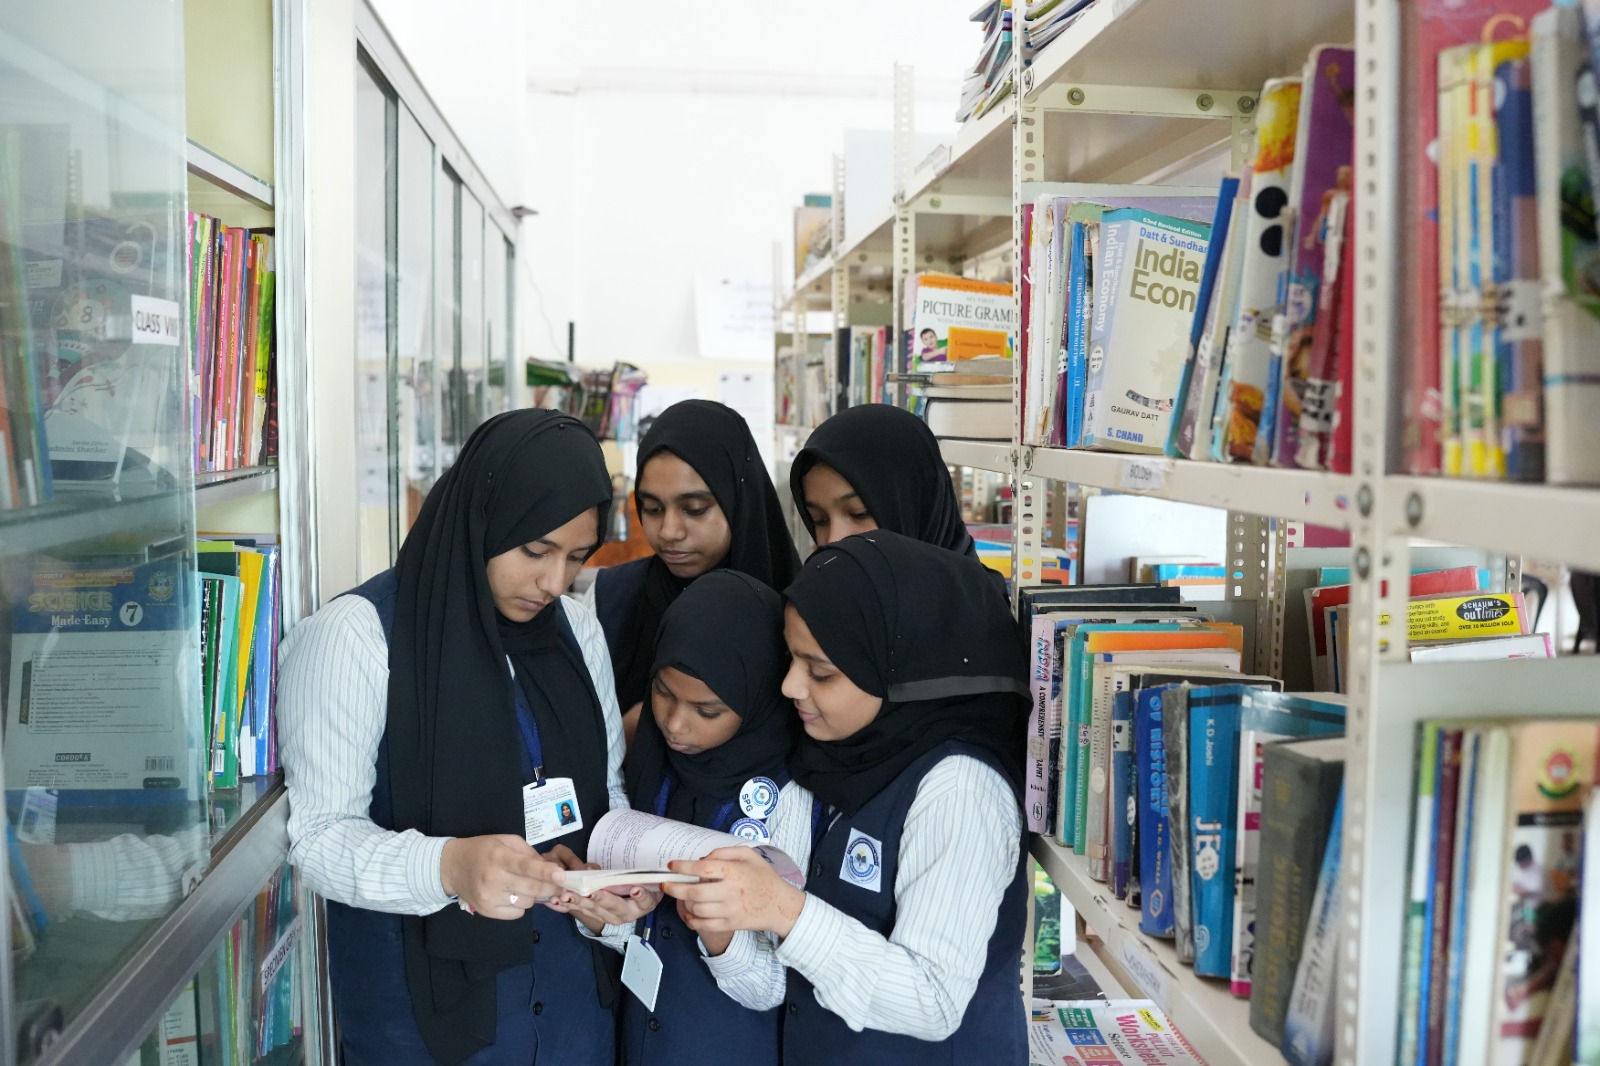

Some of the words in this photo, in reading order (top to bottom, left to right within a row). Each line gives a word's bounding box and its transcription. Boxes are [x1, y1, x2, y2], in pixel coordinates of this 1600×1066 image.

[1103, 223, 1121, 267] Indian
[1140, 227, 1159, 242] Datt
[1160, 233, 1167, 244] &
[1169, 235, 1208, 254] Sundhar
[1134, 238, 1200, 285] India
[1075, 276, 1083, 318] CHEMISTRY
[1094, 269, 1114, 332] Economy
[1129, 268, 1197, 314] Econ
[80, 305, 93, 324] 8
[135, 310, 160, 335] CLASS
[922, 300, 972, 320] PICTURE
[1110, 405, 1140, 418] GAURAV
[1141, 412, 1160, 422] DATT
[1107, 427, 1114, 437] S.
[1115, 429, 1144, 443] CHAND
[48, 445, 75, 453] admini
[28, 591, 113, 612] SCIENCE
[125, 604, 139, 623] 7
[1462, 600, 1502, 610] SCHAUM'S
[1480, 621, 1501, 629] MILLION
[1037, 691, 1046, 738] COMPREHENSIV
[1149, 695, 1161, 720] OF
[1206, 739, 1215, 767] Joshi
[1076, 746, 1084, 805] DEVELOPMEN
[1149, 728, 1161, 813] HISTORY
[741, 792, 754, 812] SPG
[1195, 816, 1222, 853] JE
[1108, 1032, 1132, 1060] Science
